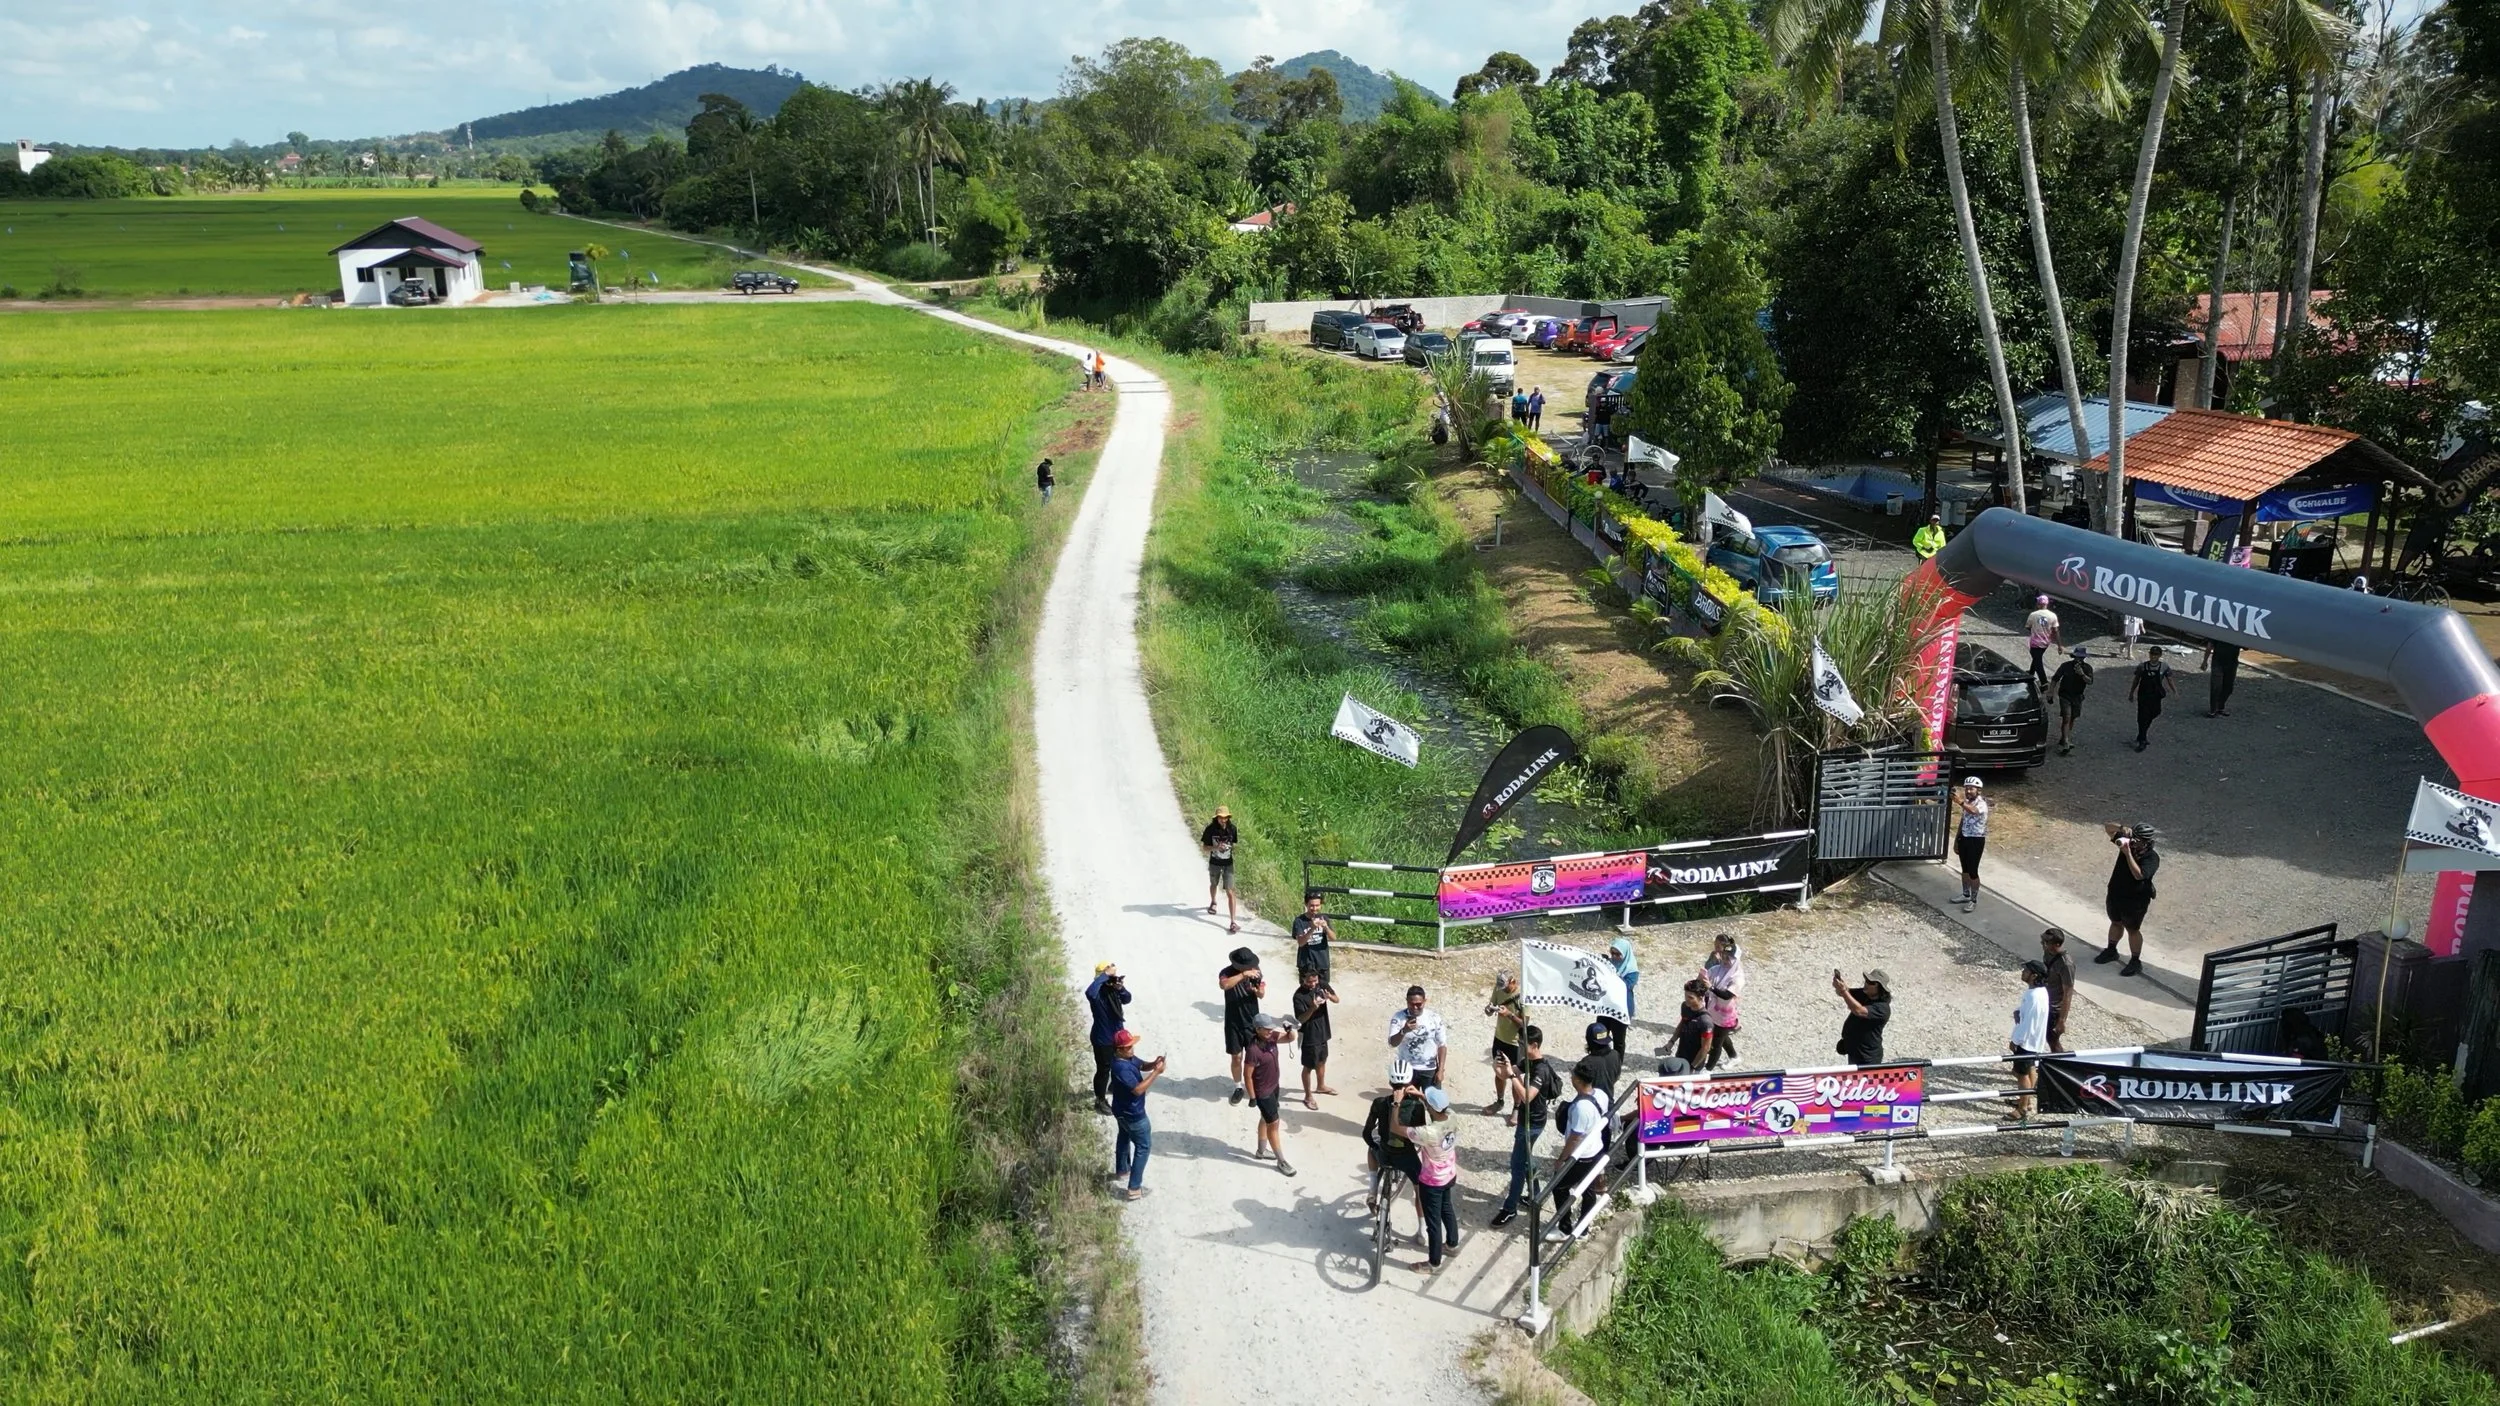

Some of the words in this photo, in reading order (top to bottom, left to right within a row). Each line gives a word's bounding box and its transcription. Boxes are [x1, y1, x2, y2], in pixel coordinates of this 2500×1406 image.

[2296, 496, 2347, 508] SCHWALBE
[2093, 566, 2272, 640] RODALINK
[1494, 748, 1560, 806] RODALINK
[1669, 858, 1780, 884] RODALINK
[1651, 1081, 1752, 1117] Welcom
[1813, 1075, 1900, 1108] Riders
[2118, 1078, 2296, 1105] RODALINK
